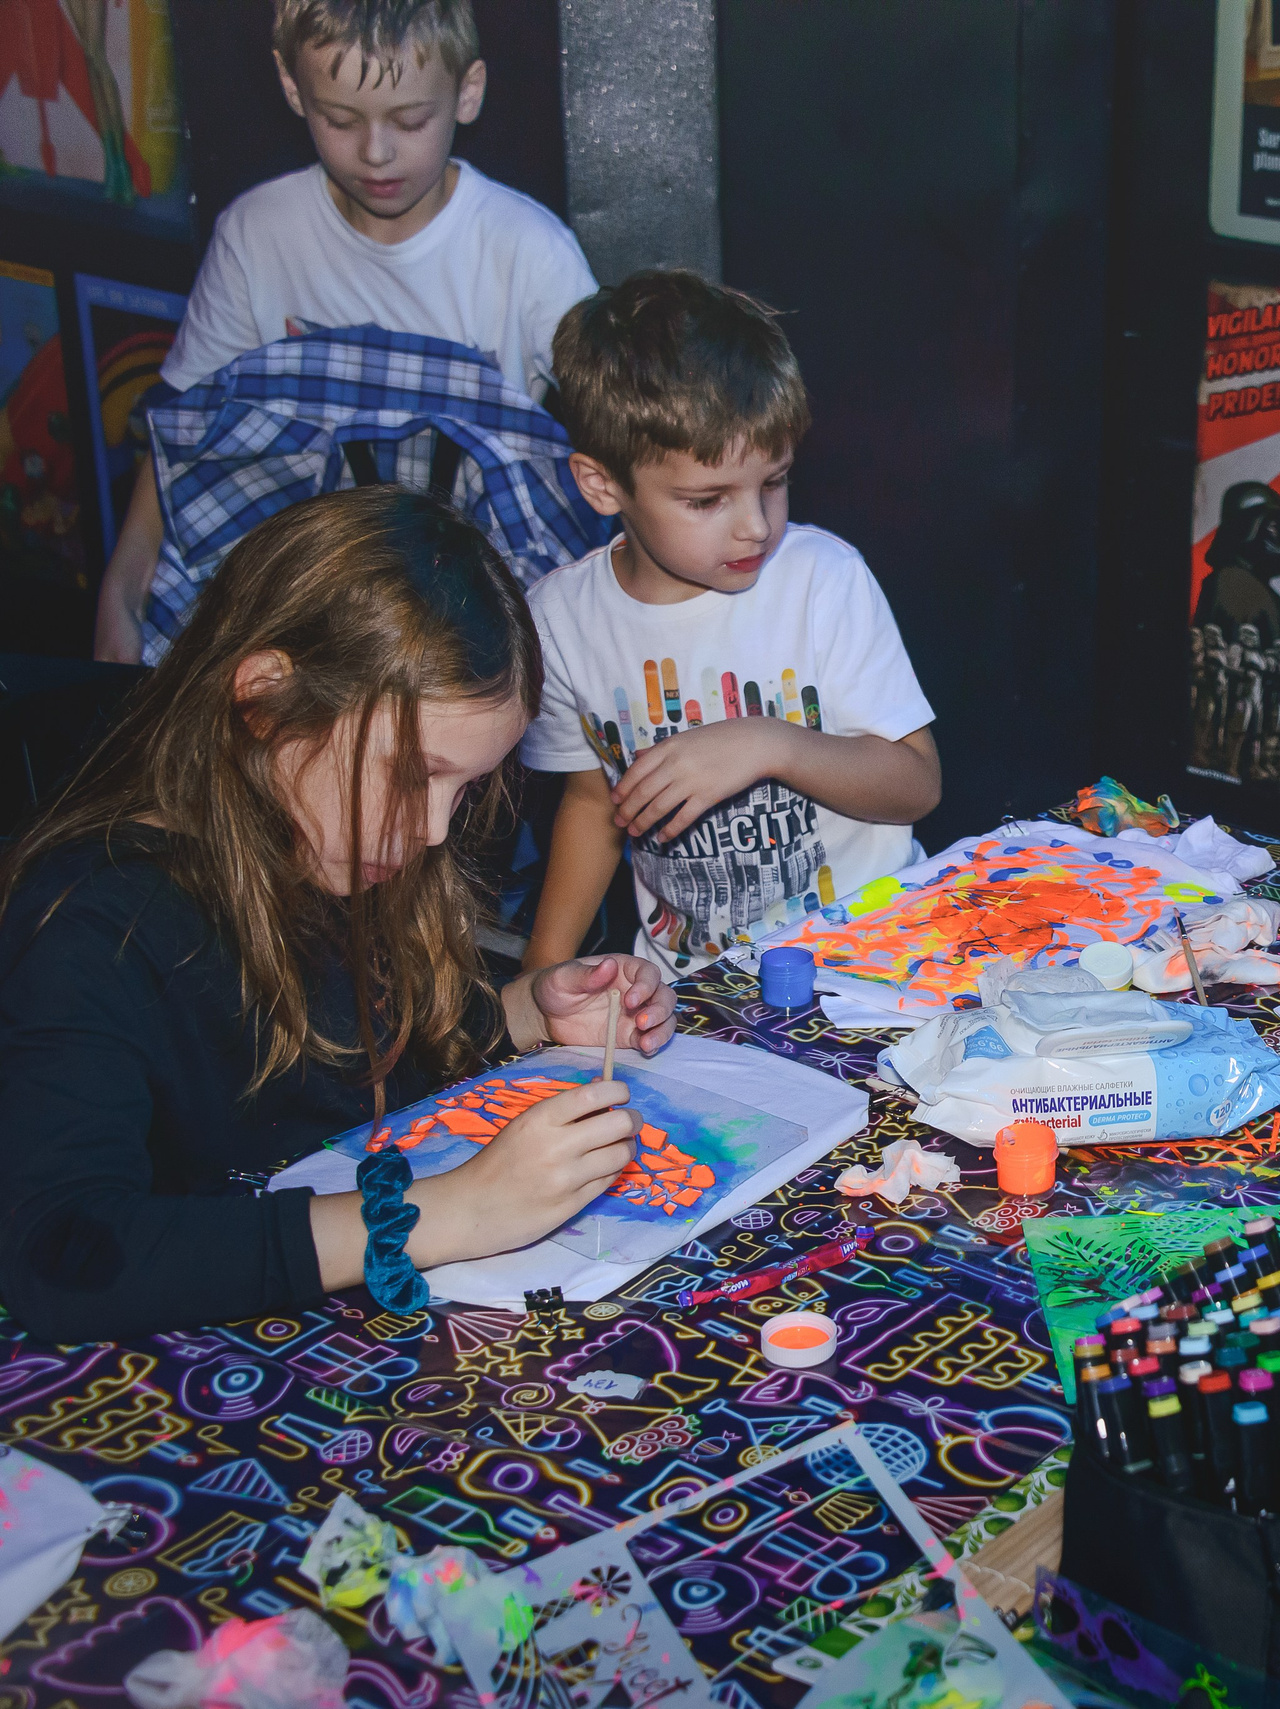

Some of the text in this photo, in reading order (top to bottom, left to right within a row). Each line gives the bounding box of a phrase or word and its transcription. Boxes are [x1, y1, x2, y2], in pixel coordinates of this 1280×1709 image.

[728, 797, 811, 853] CITY
[1010, 1080, 1133, 1096] ОЧИЩАЮЩИЕ ВЛАЖНЫЕ САЛФЕТКИ
[1011, 1090, 1153, 1114] АНТИБАКТЕРИАЛЬНЫЕ
[1213, 1102, 1231, 1119] 120
[1092, 1112, 1148, 1125] DERMA PROTECT
